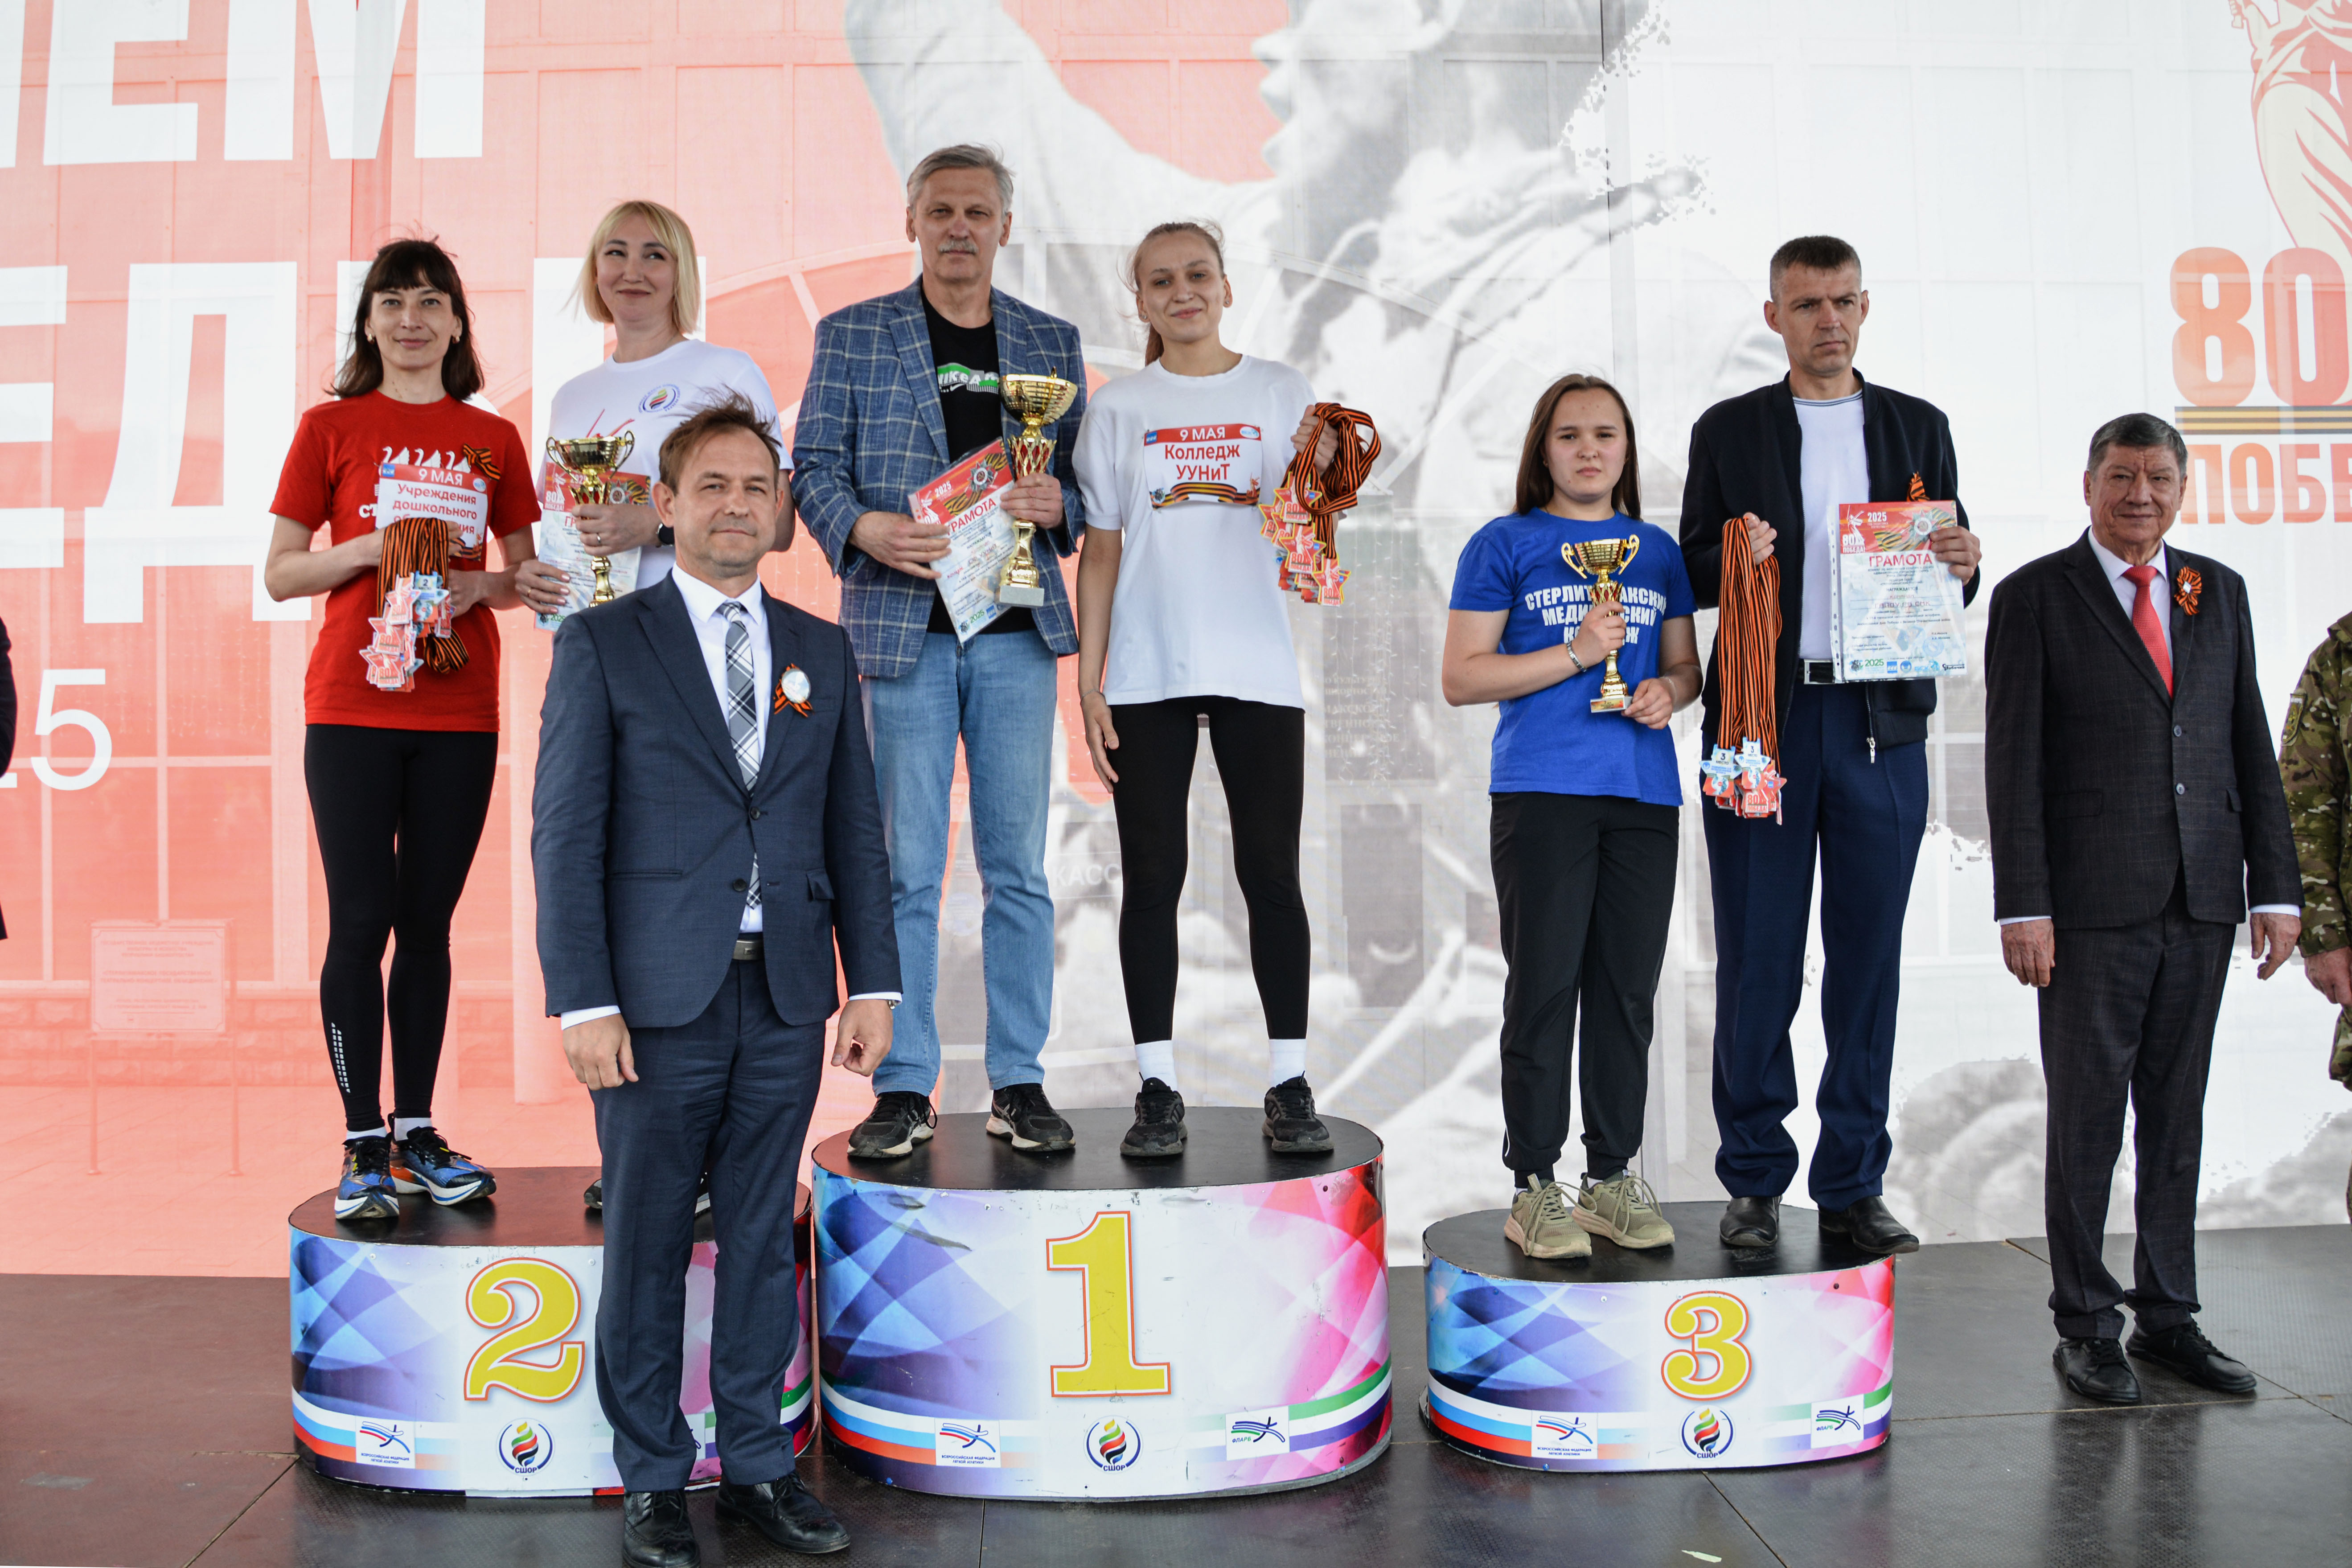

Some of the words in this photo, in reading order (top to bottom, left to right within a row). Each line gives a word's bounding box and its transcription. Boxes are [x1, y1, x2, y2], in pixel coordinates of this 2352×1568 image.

[0, 0, 485, 168] ЕМ
[2170, 246, 2350, 407] 80
[1180, 429, 1188, 441] 9
[1192, 427, 1226, 440] МАЯ
[1165, 444, 1240, 461] Колледж
[419, 468, 428, 481] 9
[431, 469, 463, 486] МАЯ
[1176, 463, 1230, 481] УУНиТ
[398, 484, 476, 505] Учреждения
[546, 491, 557, 502] 80
[935, 480, 952, 497] 2025
[392, 501, 477, 520] дошкольного
[1287, 503, 1299, 512] 80
[1867, 511, 1888, 522] 2025
[1842, 534, 1854, 546] 80
[1292, 552, 1303, 562] 80
[1869, 553, 1933, 567] ГРАМОТА
[1323, 587, 1334, 597] 80
[1542, 603, 1657, 627] МЕДИСКИЙ
[1864, 659, 1884, 667] 2025
[378, 667, 391, 678] 80
[1747, 794, 1759, 804] 80
[1046, 1211, 1172, 1398] 1
[464, 1257, 585, 1403] 2
[1661, 1291, 1753, 1401] 3
